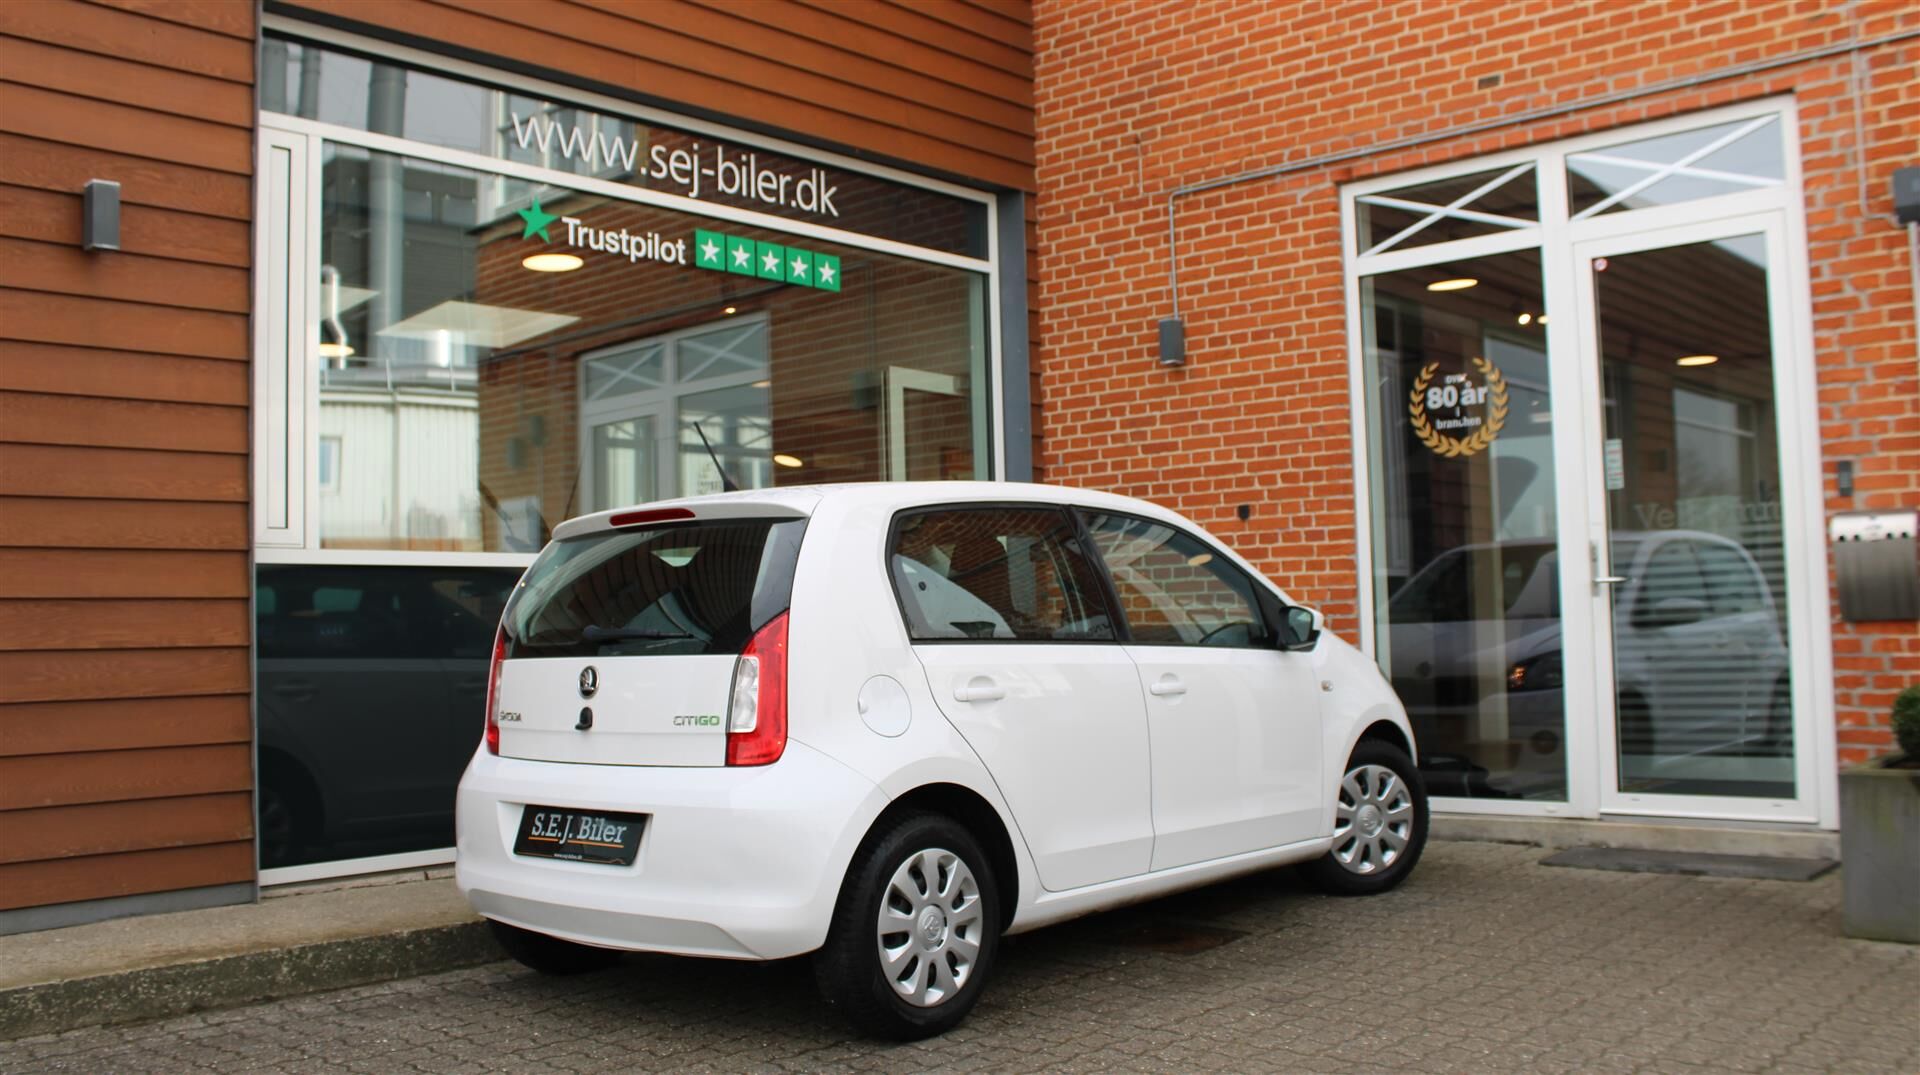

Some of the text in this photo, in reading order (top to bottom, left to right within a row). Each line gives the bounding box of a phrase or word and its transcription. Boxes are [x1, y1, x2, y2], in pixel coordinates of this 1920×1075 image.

[511, 111, 839, 218] www.sej-biler.dk
[561, 215, 687, 265] Trustpilot
[1426, 380, 1488, 409] 80 år
[531, 812, 627, 845] S.E.J. Biler
